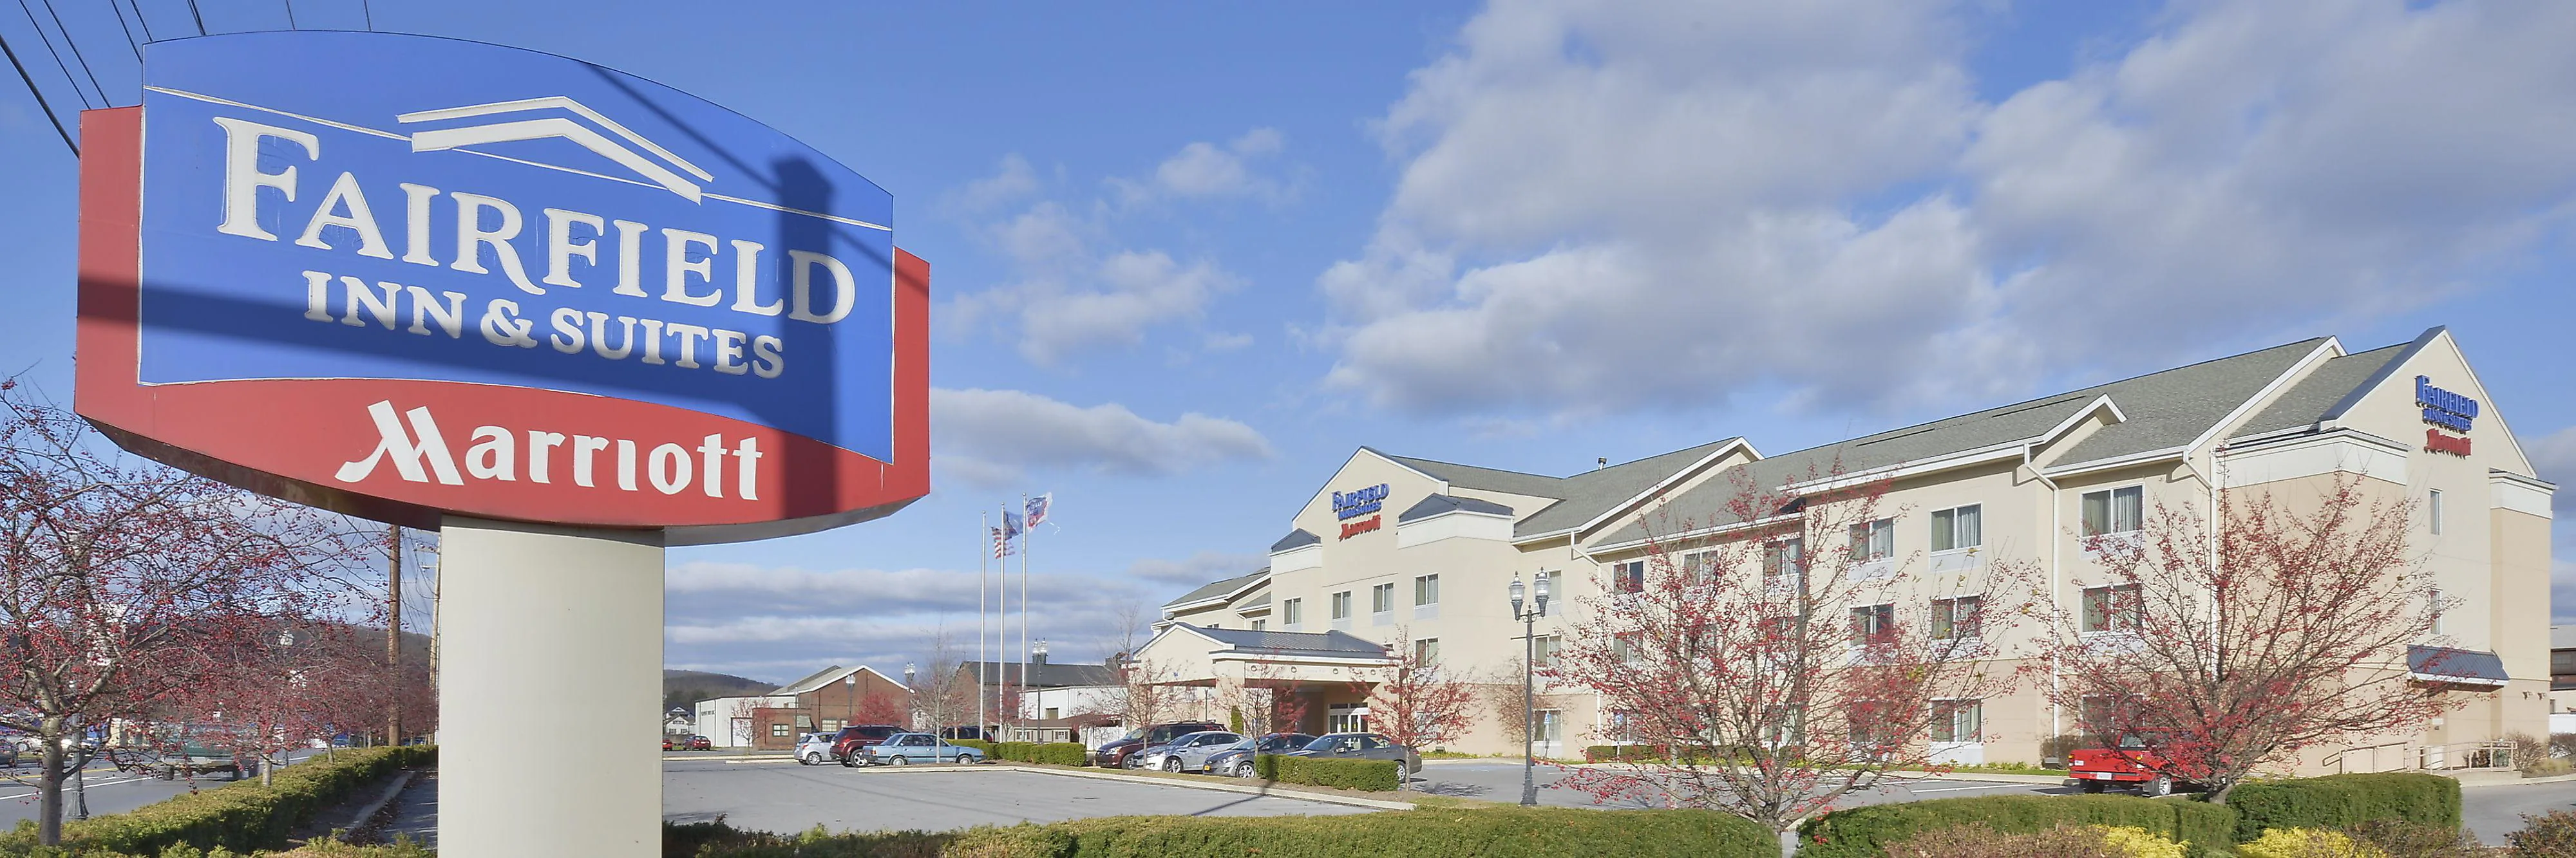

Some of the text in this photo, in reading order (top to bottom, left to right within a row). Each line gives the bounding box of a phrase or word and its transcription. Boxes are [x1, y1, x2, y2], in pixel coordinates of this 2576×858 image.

[213, 117, 857, 324] FAIRFIELD
[302, 270, 784, 379] INN & SUITES
[2415, 375, 2479, 420] FAIRFIELD
[335, 400, 764, 501] Marriott
[1331, 483, 1390, 512] FAIRFIELD
